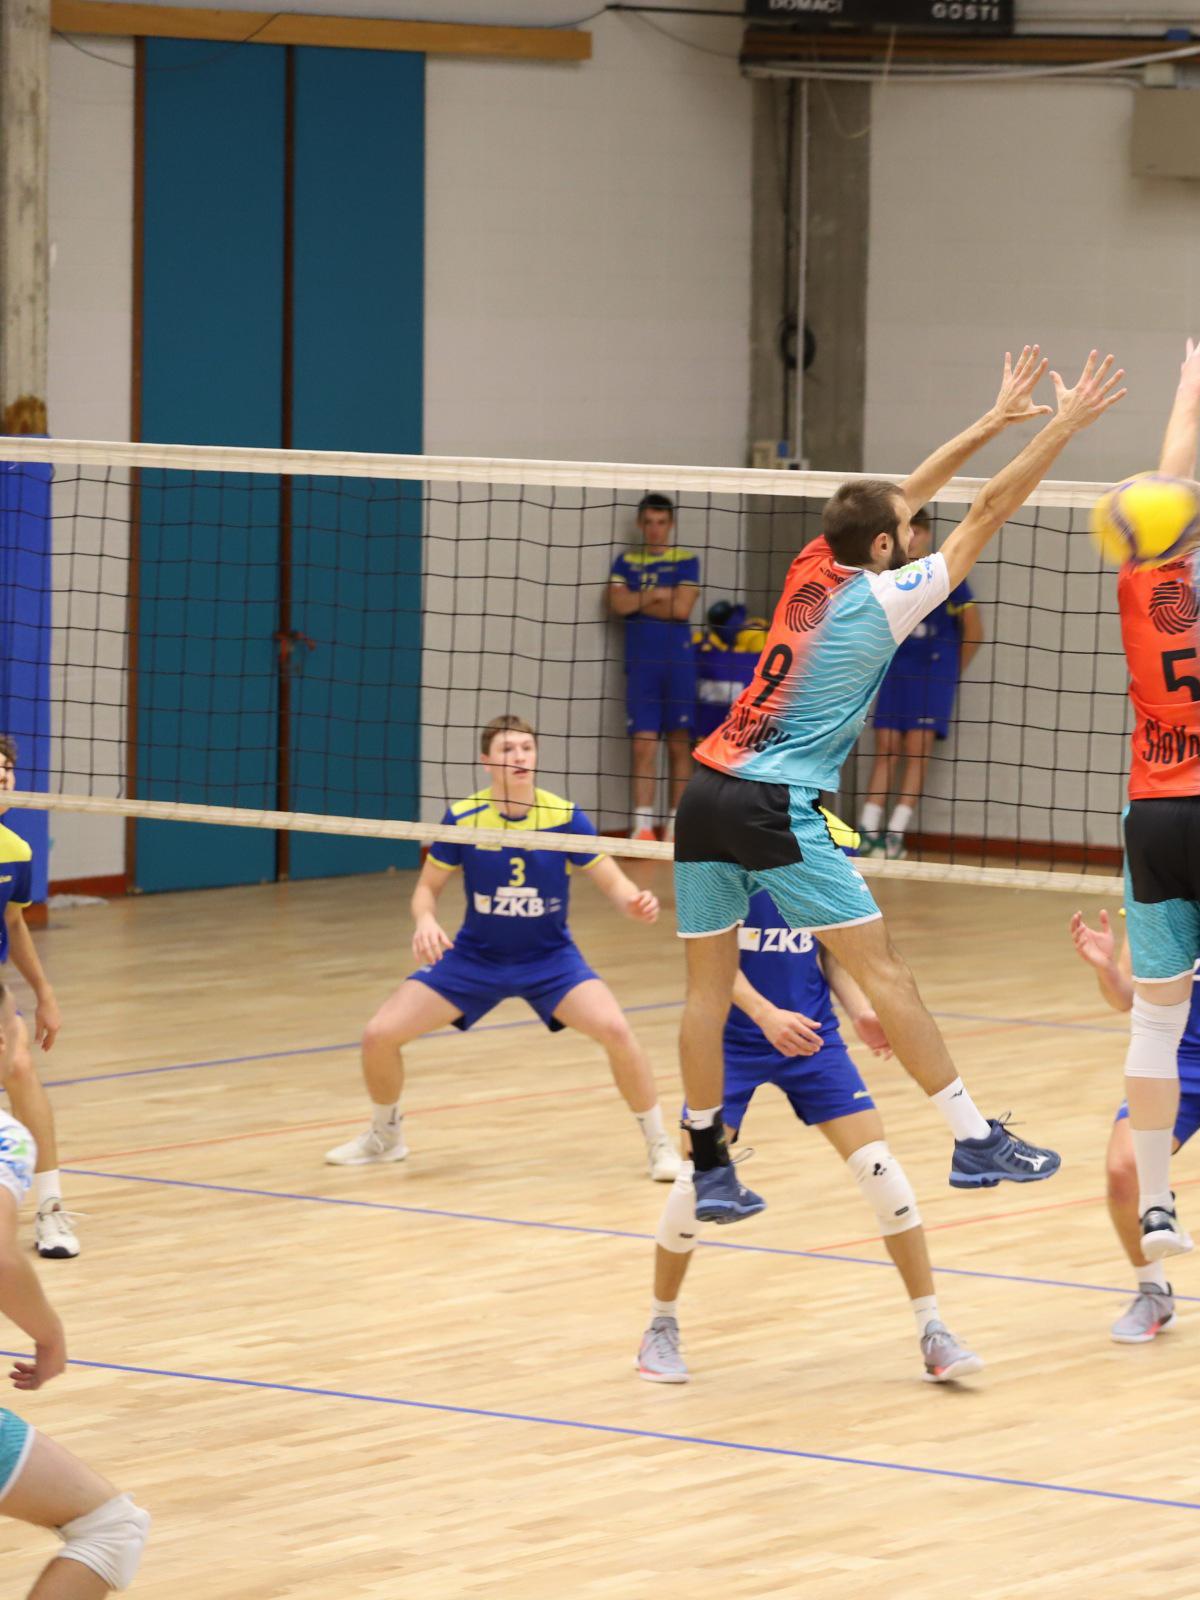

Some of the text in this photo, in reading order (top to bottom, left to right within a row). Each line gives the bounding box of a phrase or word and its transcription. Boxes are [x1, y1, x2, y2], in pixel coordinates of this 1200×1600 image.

[931, 4, 999, 21] GOSTI
[750, 643, 794, 708] 9
[508, 856, 527, 887] 3
[492, 896, 545, 918] ZKB
[760, 927, 815, 954] ZKB
